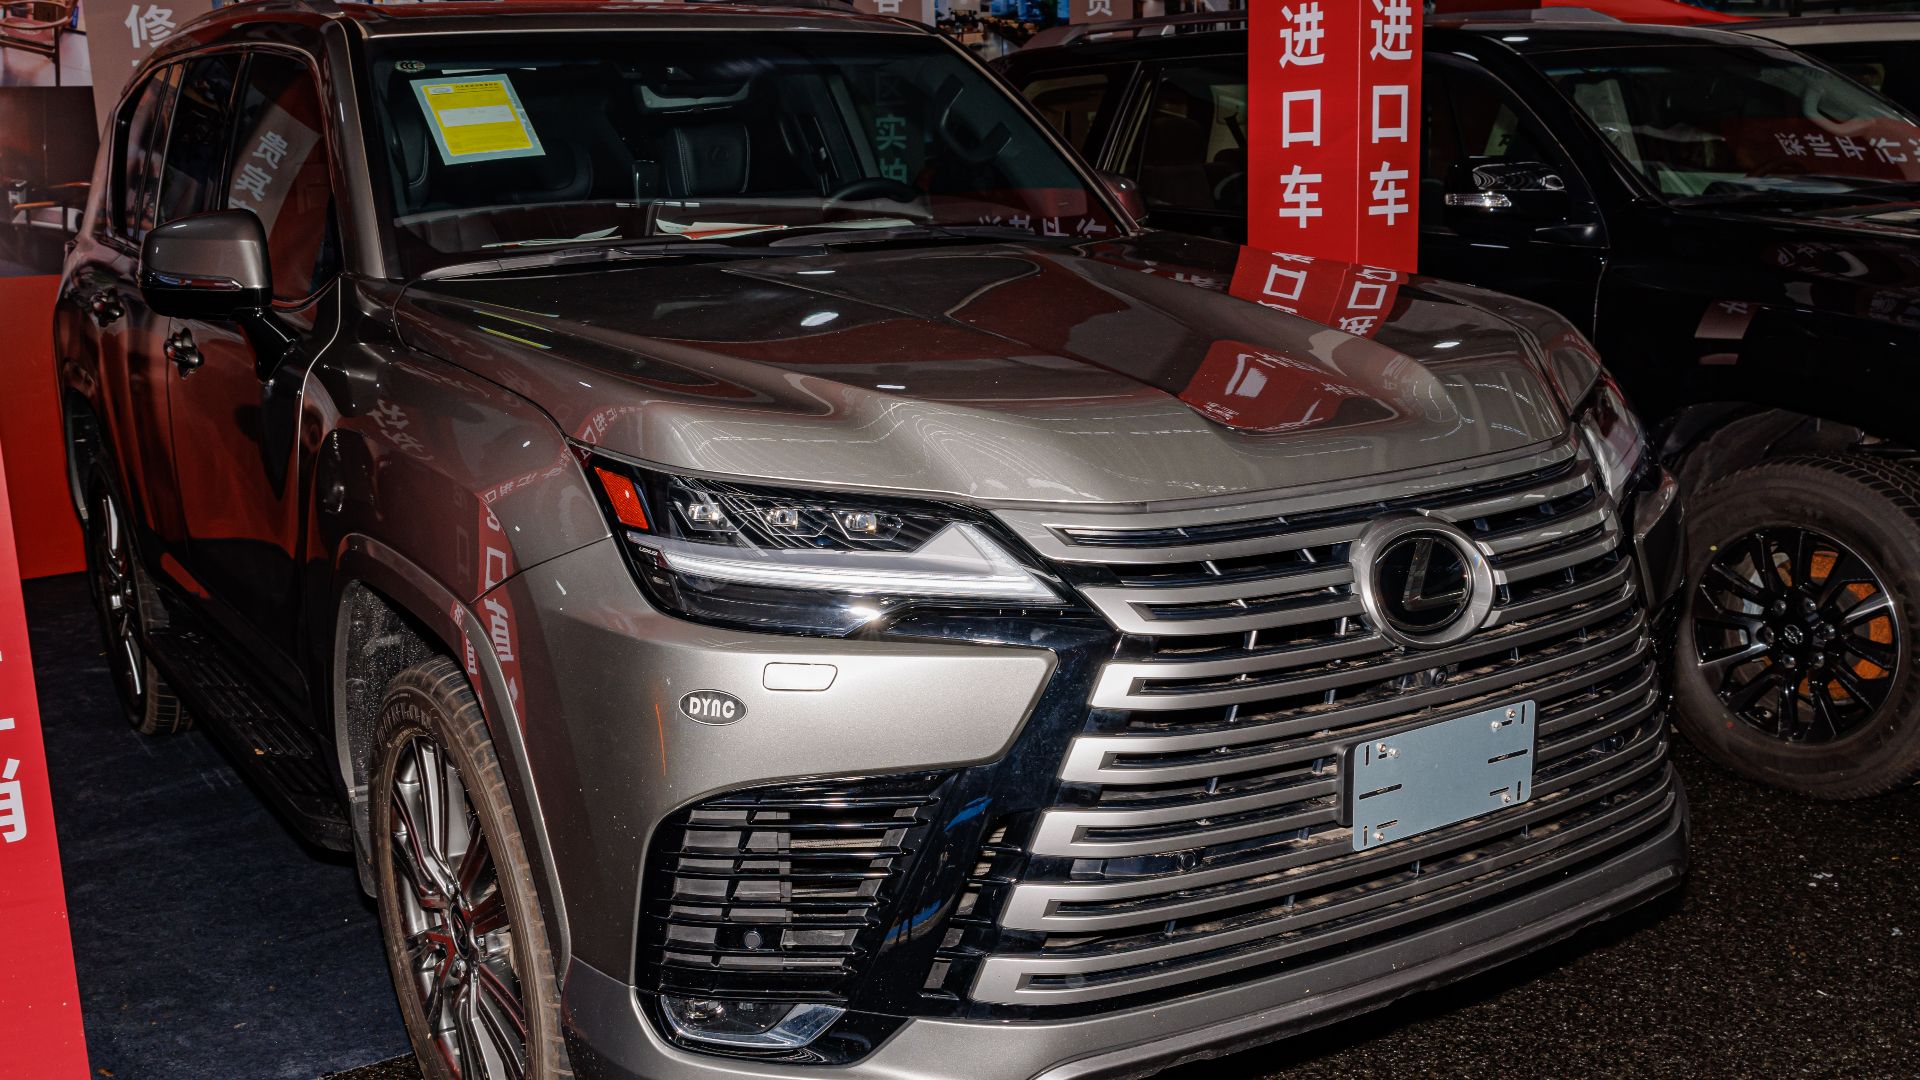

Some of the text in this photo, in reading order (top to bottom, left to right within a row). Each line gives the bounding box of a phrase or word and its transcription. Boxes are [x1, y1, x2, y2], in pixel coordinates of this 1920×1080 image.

[1279, 2, 1325, 229] 进口车
[1368, 0, 1413, 226] 进口车
[689, 696, 735, 719] DYNC
